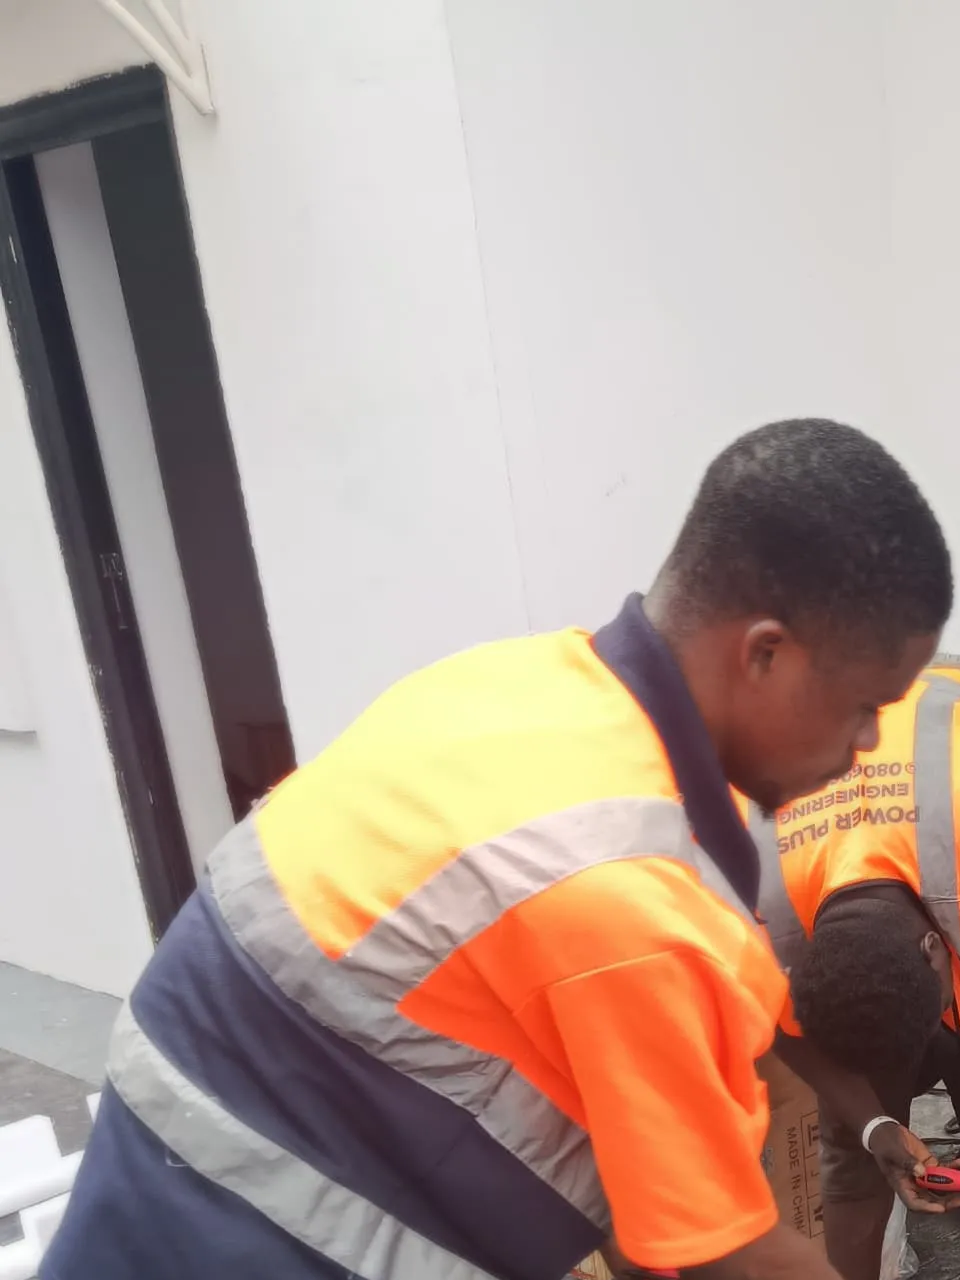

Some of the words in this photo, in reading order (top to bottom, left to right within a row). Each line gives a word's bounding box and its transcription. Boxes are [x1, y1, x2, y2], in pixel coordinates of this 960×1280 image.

[779, 783, 909, 825] ENGINEERING
[835, 805, 920, 831] POWER
[777, 819, 829, 853] PLUS
[784, 1126, 800, 1170] MADE
[791, 1174, 801, 1190] IN
[791, 1195, 807, 1232] CHIN
